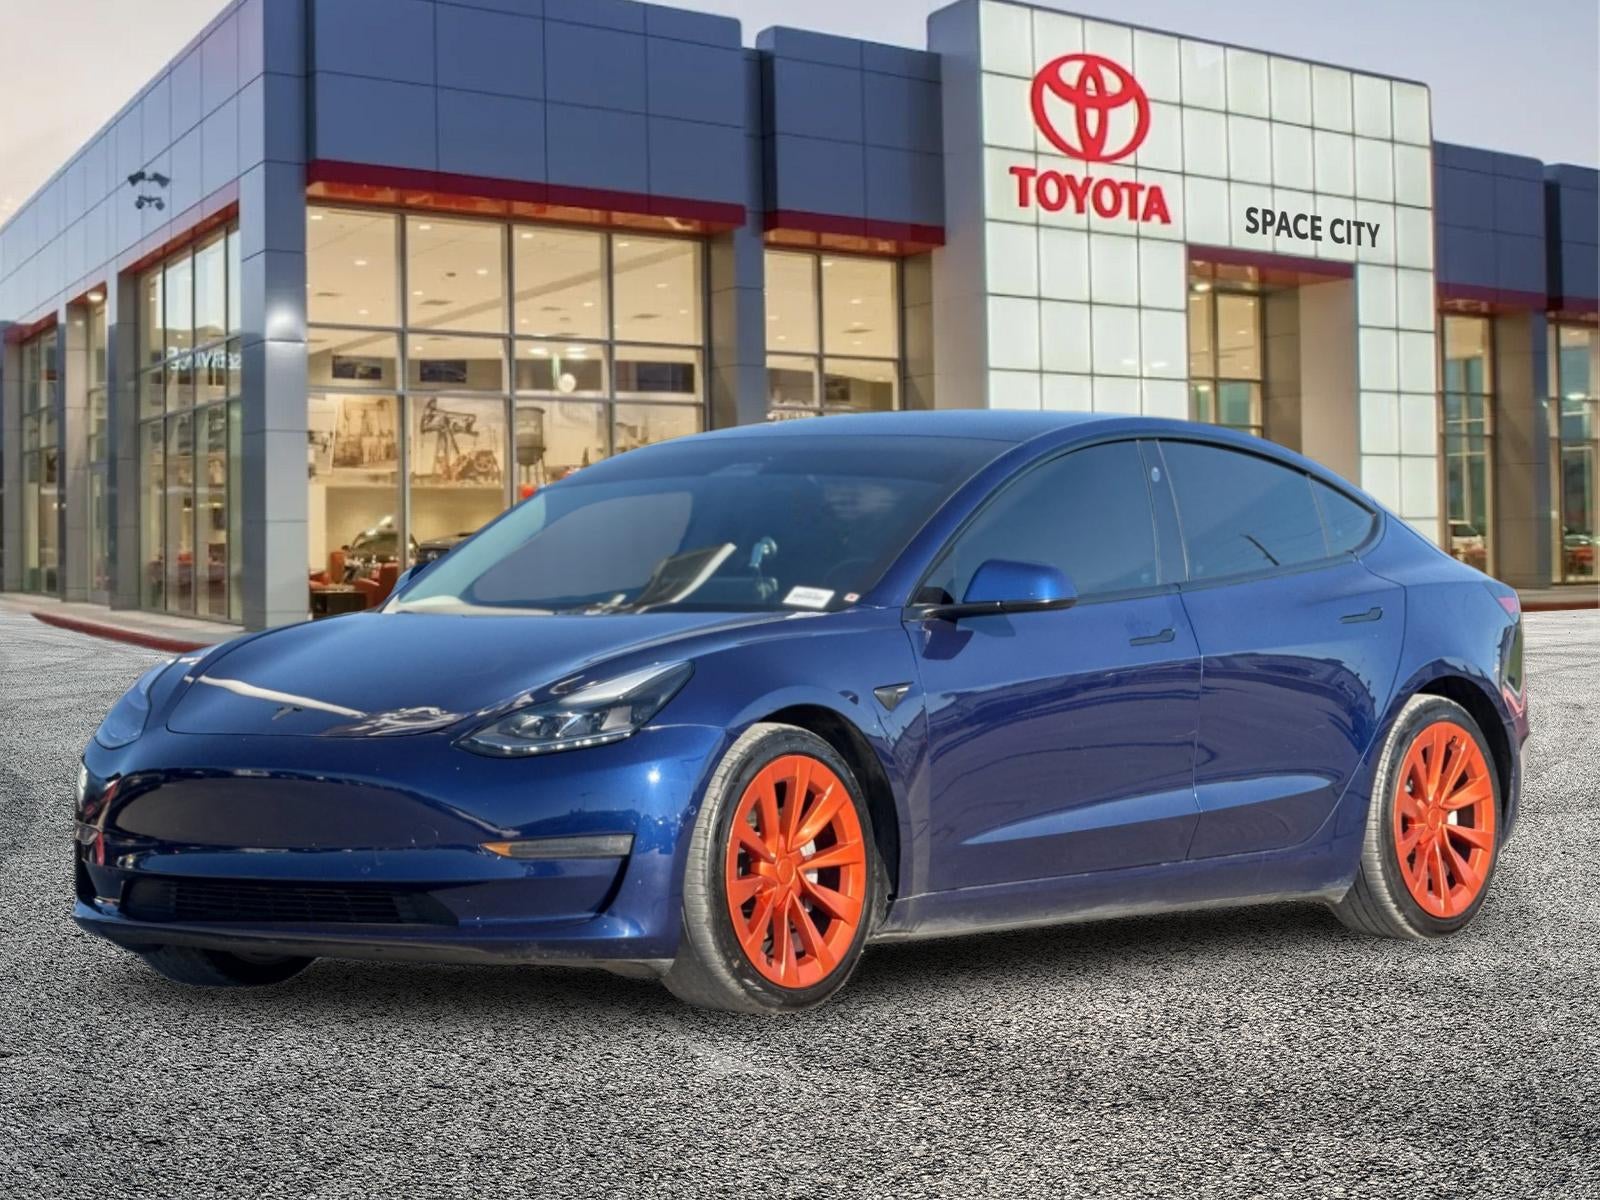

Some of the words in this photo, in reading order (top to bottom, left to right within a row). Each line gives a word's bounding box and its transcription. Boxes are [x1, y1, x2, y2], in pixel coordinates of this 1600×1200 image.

[1009, 166, 1171, 224] TOYOTA
[1245, 206, 1324, 242] SPACE
[1329, 217, 1381, 248] CITY
